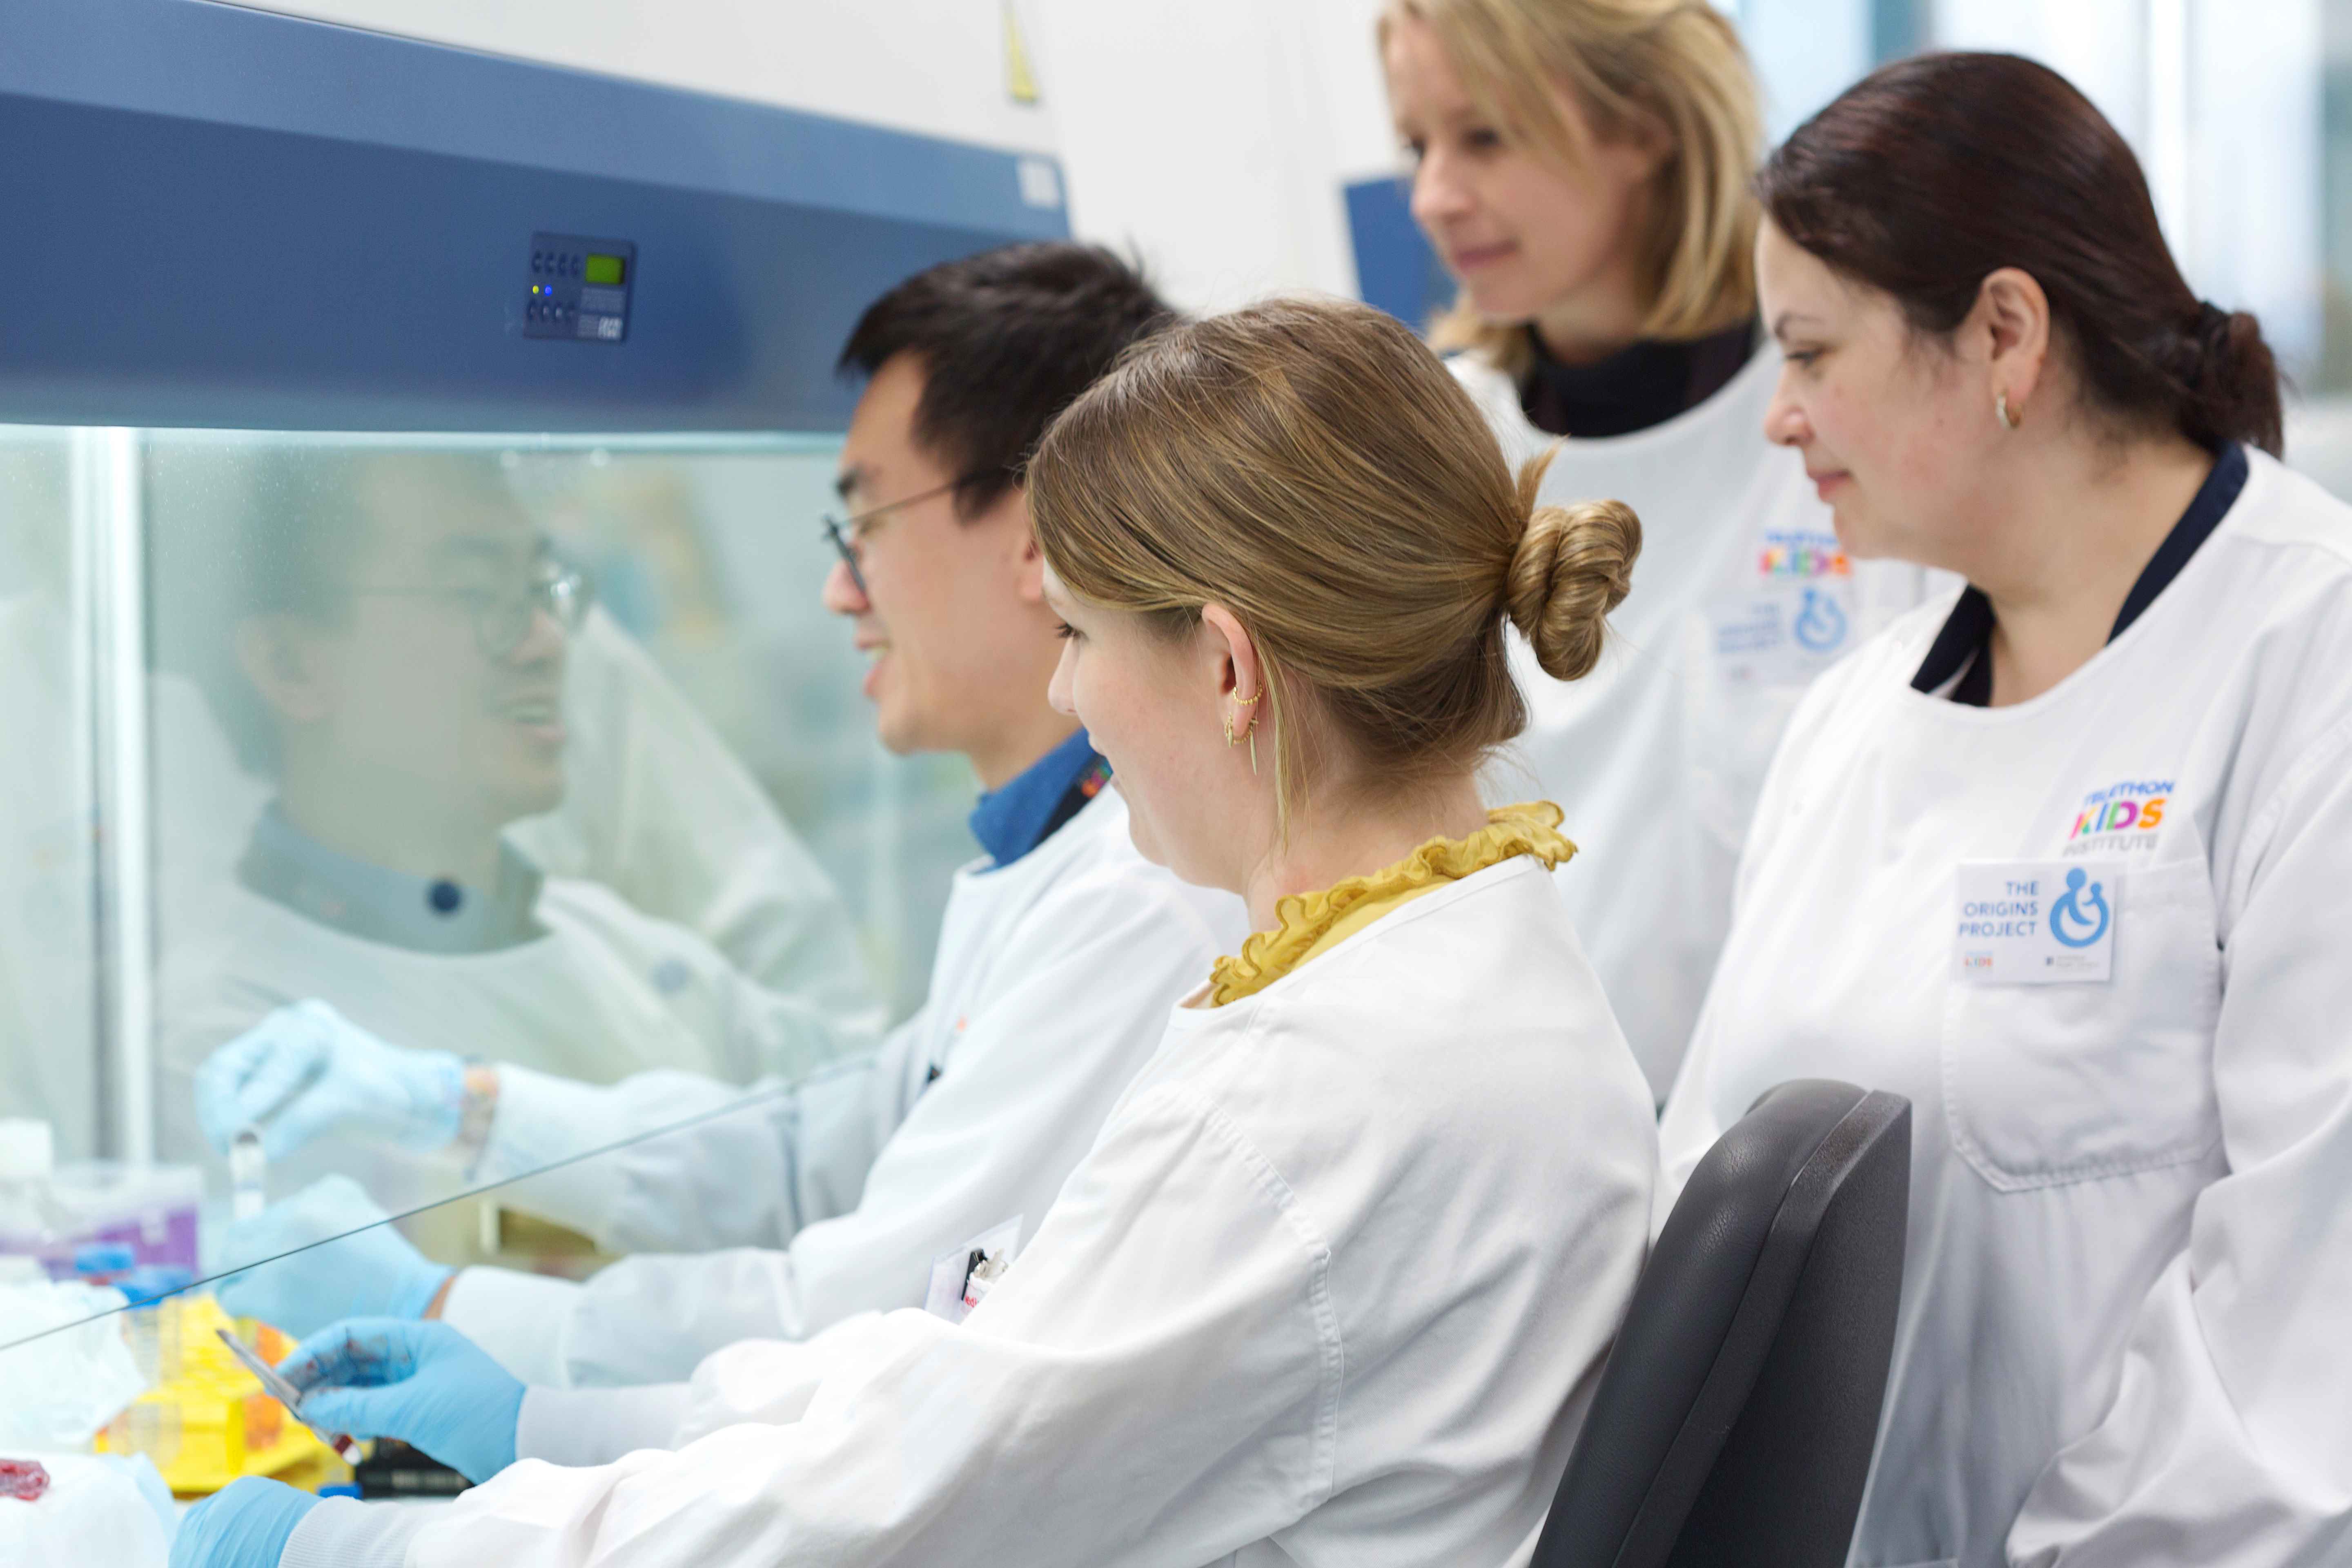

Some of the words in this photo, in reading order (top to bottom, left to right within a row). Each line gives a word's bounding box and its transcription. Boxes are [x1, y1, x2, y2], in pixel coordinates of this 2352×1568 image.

[2069, 797, 2166, 840] KIDS
[2006, 881, 2039, 895] THE
[1964, 902, 2038, 916] ORIGINS
[1959, 921, 2036, 937] PROJECT
